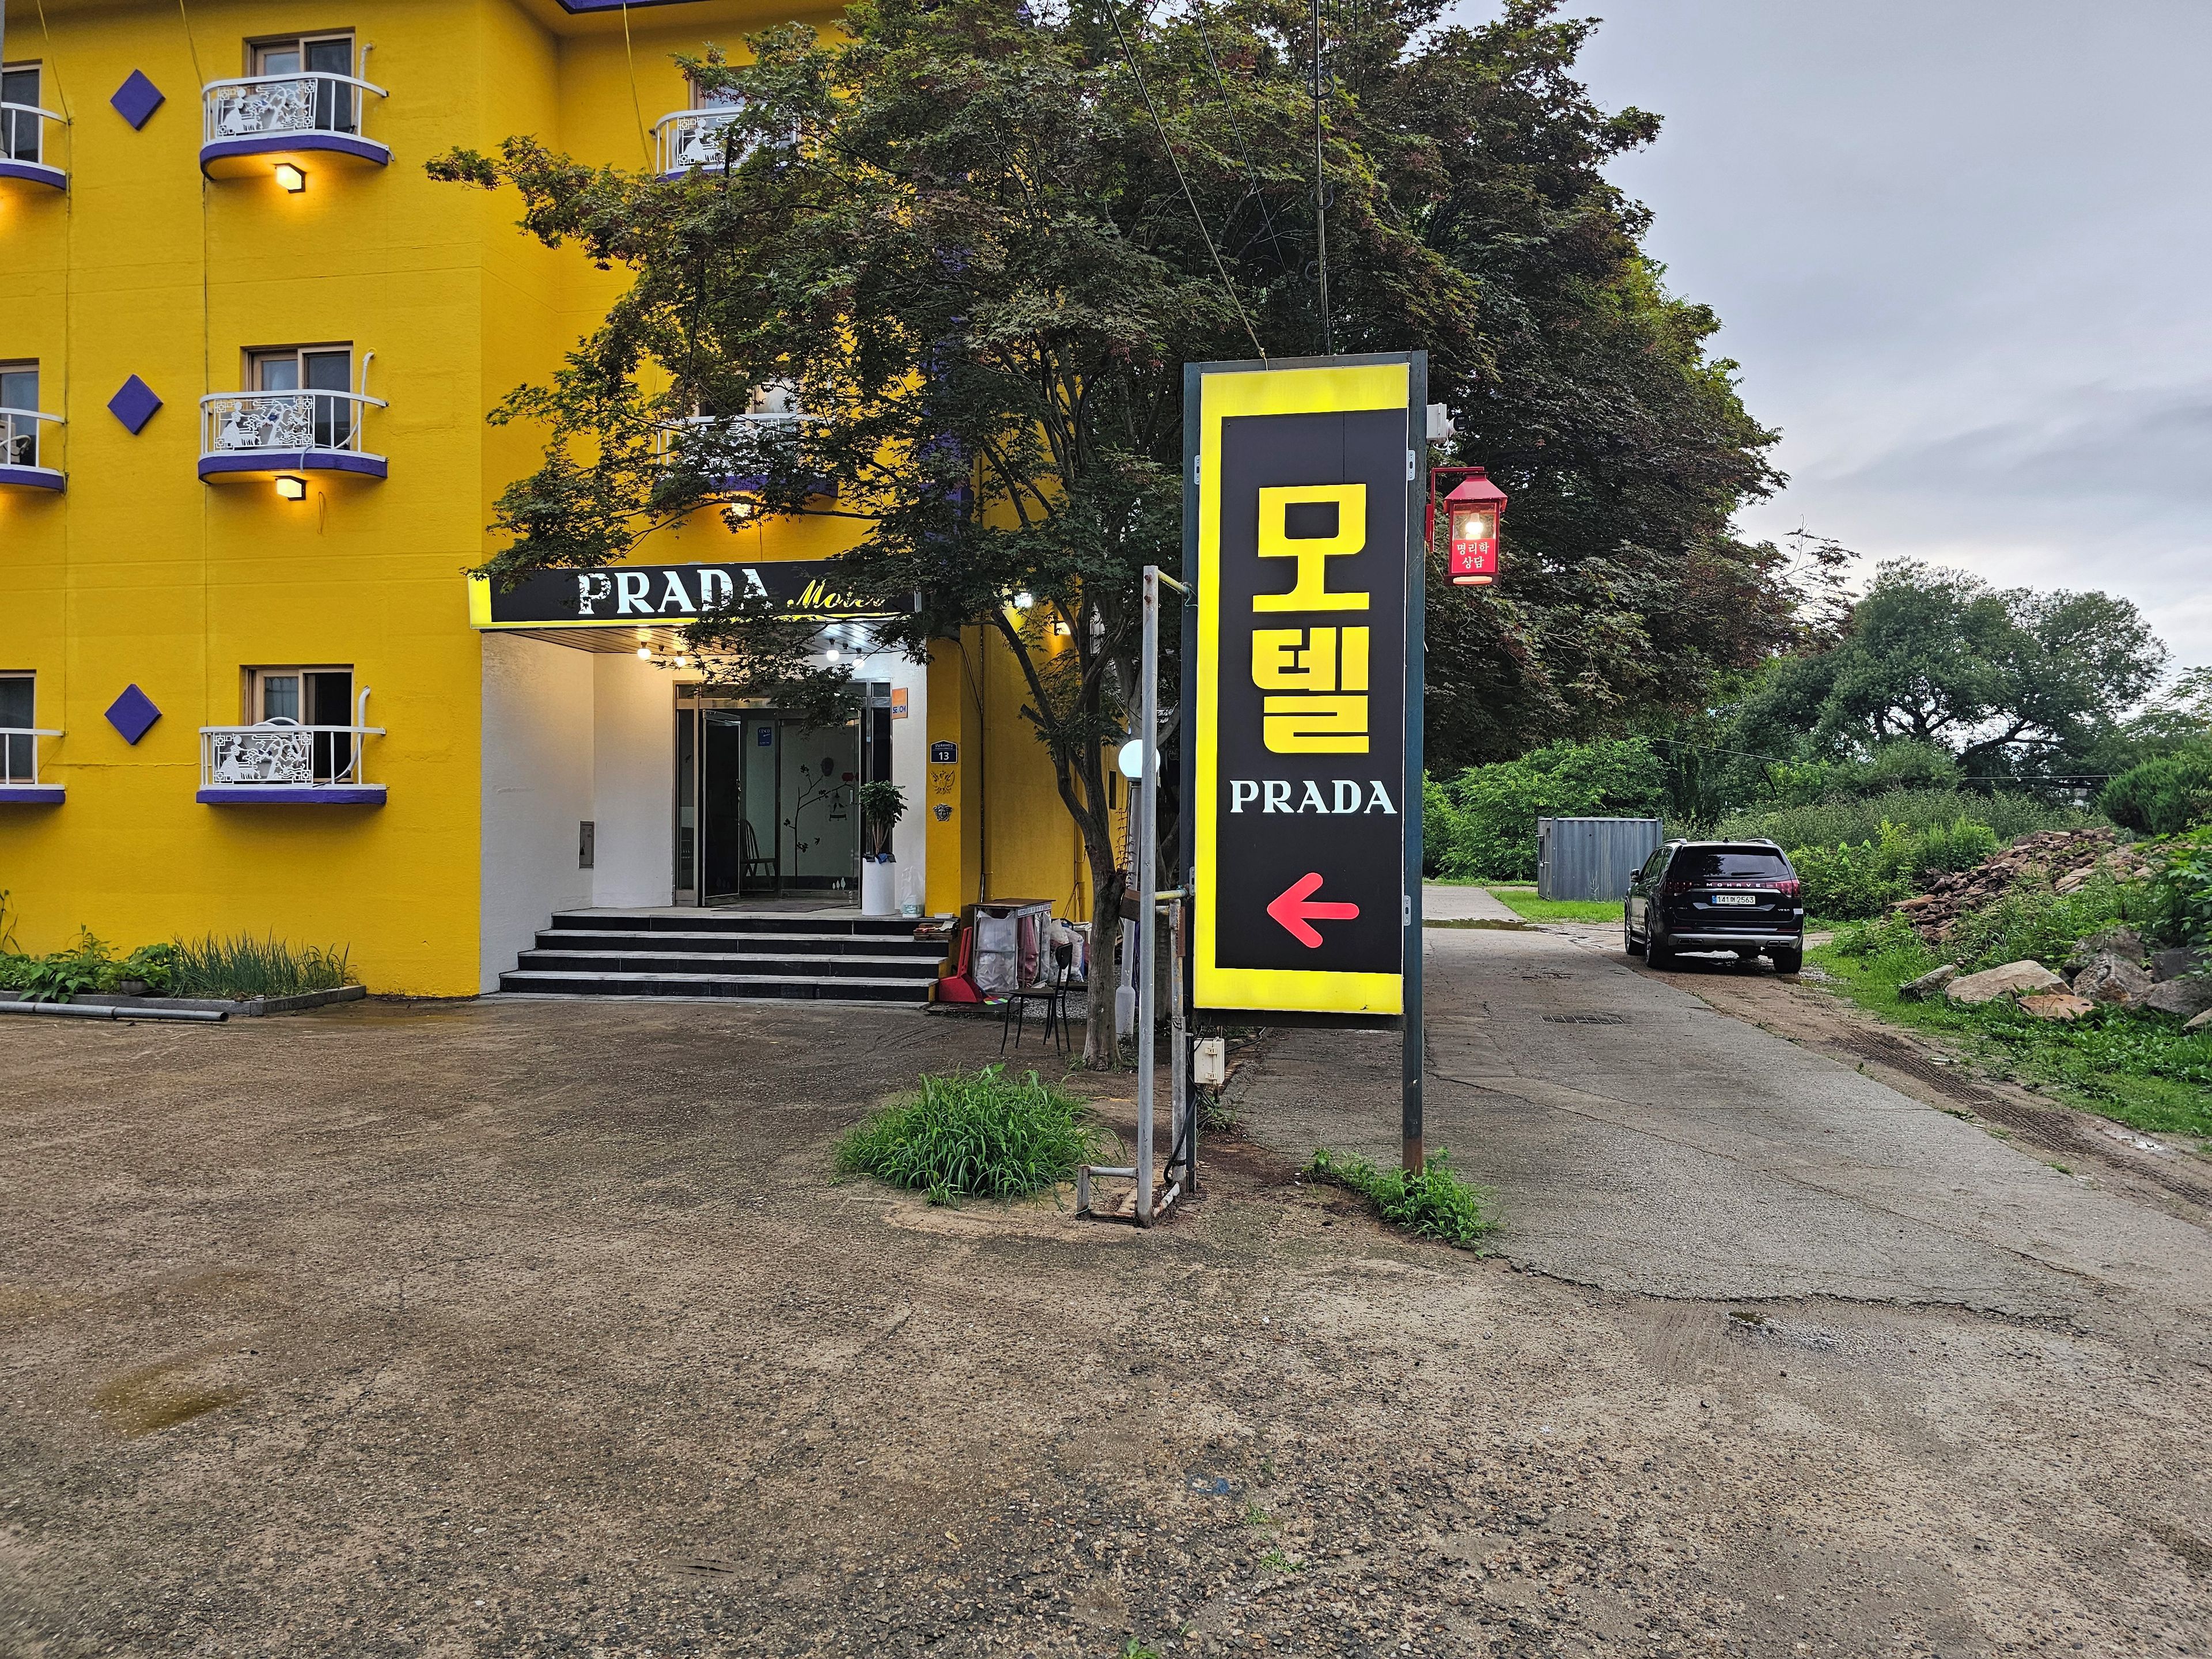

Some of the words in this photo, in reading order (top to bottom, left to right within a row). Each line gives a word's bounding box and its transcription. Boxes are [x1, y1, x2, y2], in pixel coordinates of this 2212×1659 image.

[1456, 541, 1490, 555] 명리학
[1462, 555, 1484, 569] 상담
[577, 568, 774, 615] PRADA
[1252, 483, 1370, 753] 모텔
[893, 705, 906, 714] SEOM
[938, 752, 949, 760] 13
[1229, 780, 1398, 814] PRADA
